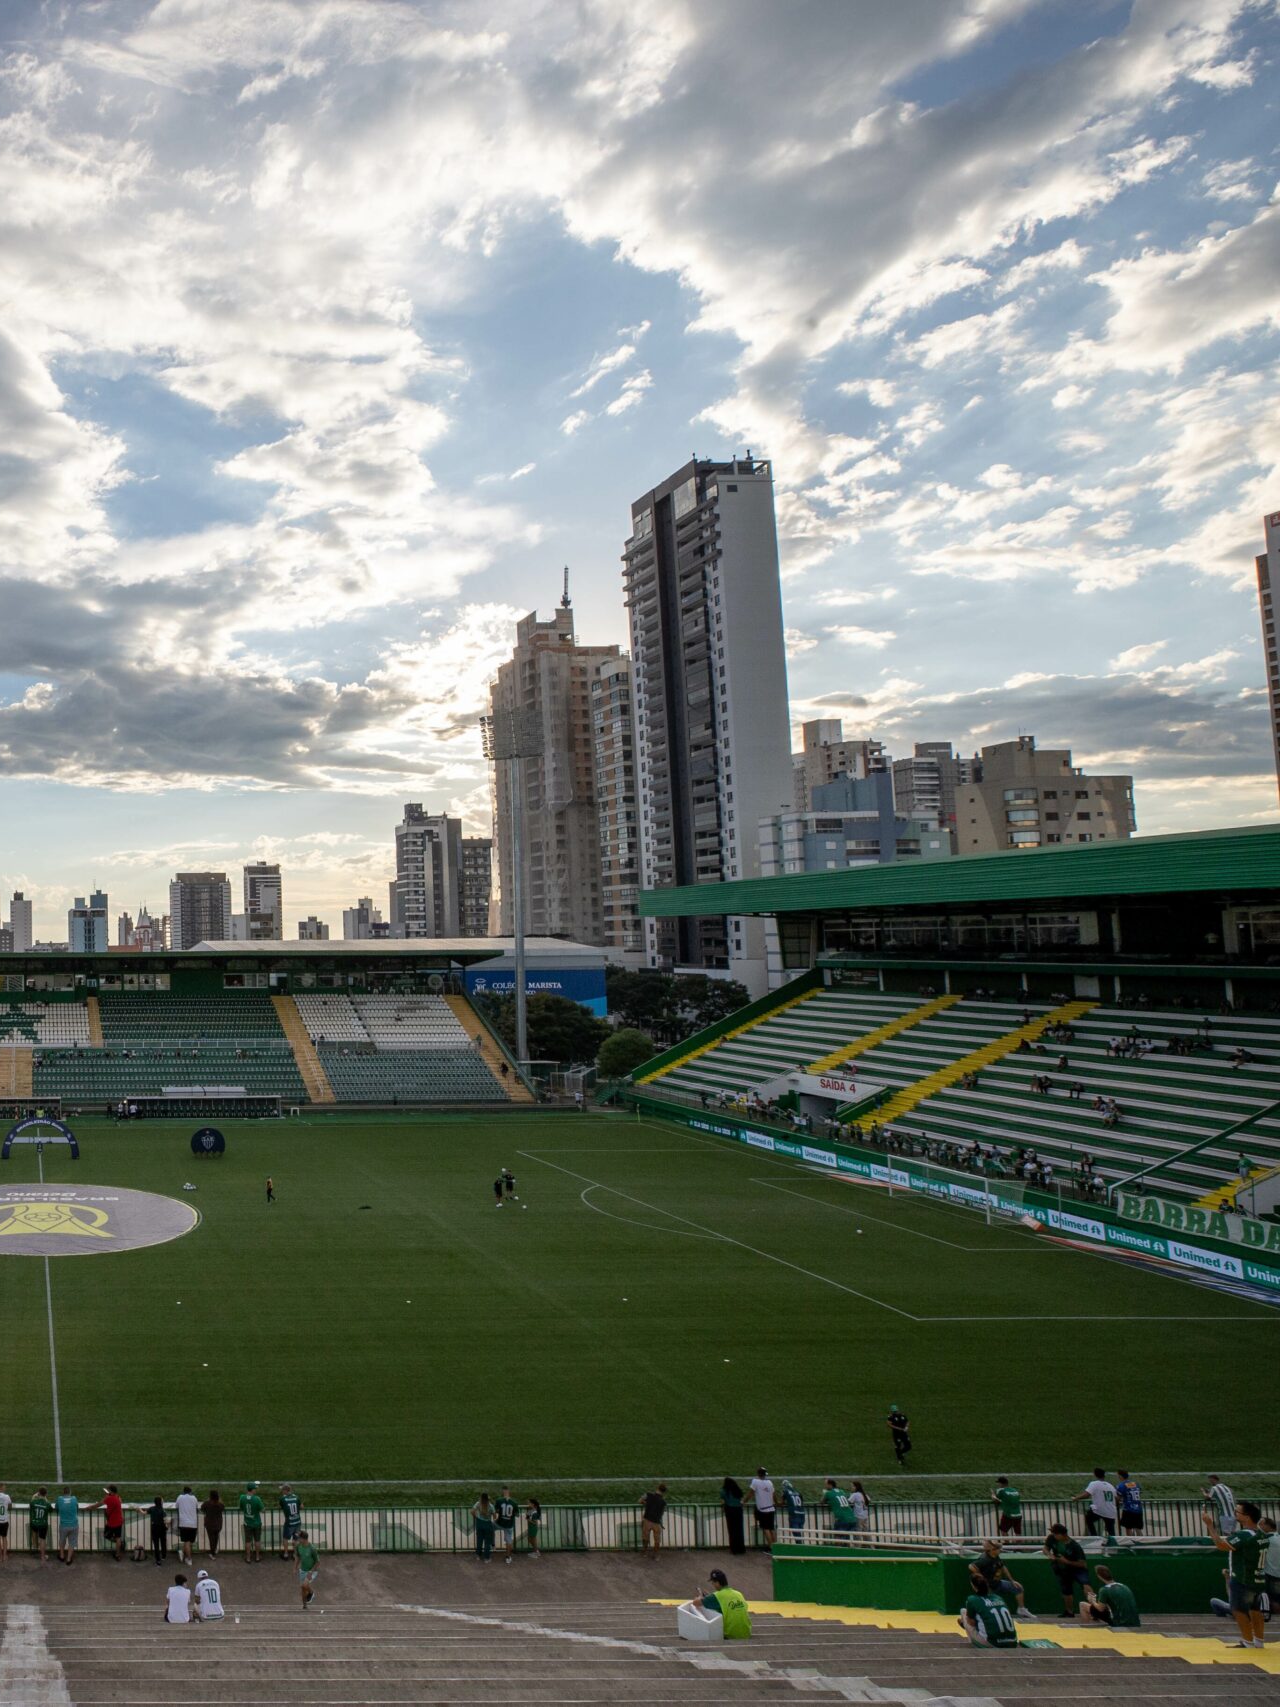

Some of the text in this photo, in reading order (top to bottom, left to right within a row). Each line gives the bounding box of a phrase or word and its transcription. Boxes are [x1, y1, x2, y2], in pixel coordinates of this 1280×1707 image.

[820, 1078, 856, 1094] SAÍDA 4
[775, 1141, 795, 1154] Unimed
[804, 1149, 827, 1163] Unimed
[838, 1158, 862, 1171] Unimed
[1001, 1201, 1035, 1217] Unimed
[1051, 1214, 1089, 1232] Unimed
[1121, 1195, 1229, 1240] BARRA
[1107, 1229, 1151, 1249] Unimed
[1174, 1246, 1221, 1268] Unimed
[791, 1495, 802, 1507] 10
[836, 1495, 849, 1508] 10
[1103, 1490, 1113, 1502] 10
[35, 1508, 45, 1519] 10
[288, 1503, 298, 1515] 10
[501, 1503, 513, 1517] 10
[205, 1588, 218, 1604] 10
[990, 1607, 1014, 1632] 10
